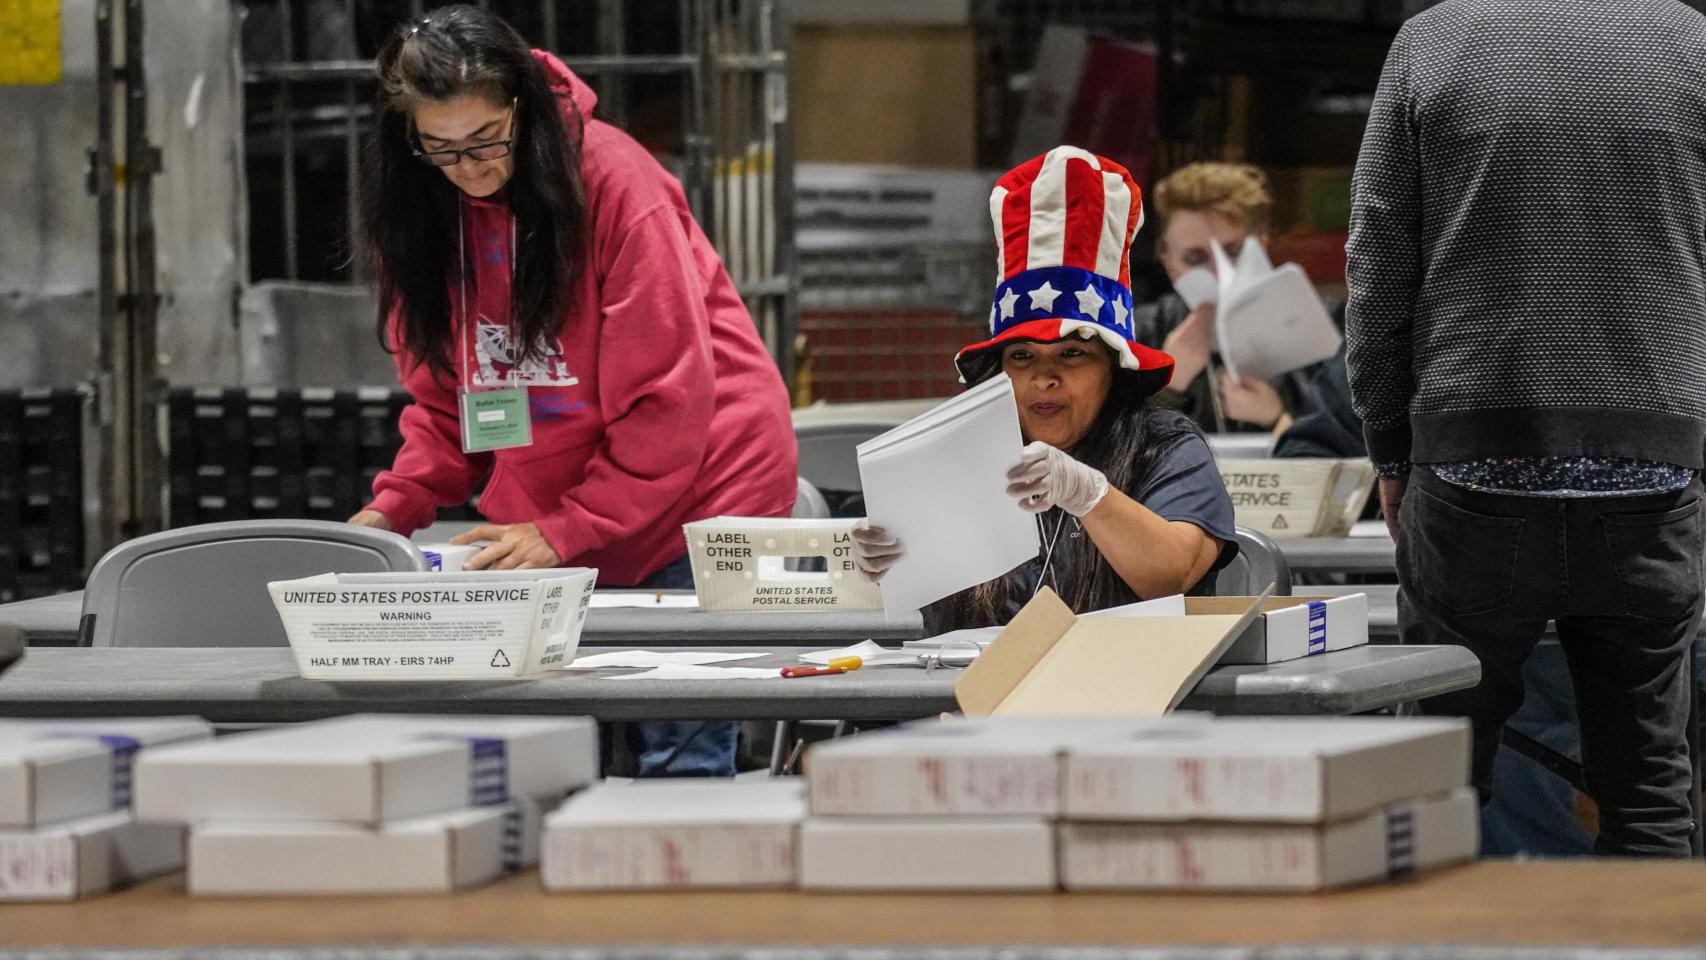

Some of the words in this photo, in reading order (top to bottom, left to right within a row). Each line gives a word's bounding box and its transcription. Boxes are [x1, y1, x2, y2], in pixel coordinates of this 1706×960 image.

[1230, 491, 1292, 506] ERVICE
[707, 533, 750, 543] LABEL
[706, 547, 752, 557] OTHER
[716, 561, 743, 571] END
[284, 591, 337, 604] UNITED
[340, 591, 397, 604] STATES
[401, 591, 460, 603] POSTAL
[464, 588, 530, 602] SERVICE
[756, 587, 792, 595] UNITED
[794, 587, 833, 595] STATES
[752, 597, 792, 605] POSTAL
[794, 597, 837, 605] SERVICE
[379, 612, 432, 621] WARNING
[311, 658, 339, 667] HALF
[342, 658, 360, 667] MM
[363, 657, 391, 667] TRAY
[400, 657, 425, 666] EIRS
[428, 656, 454, 666] 74HP
